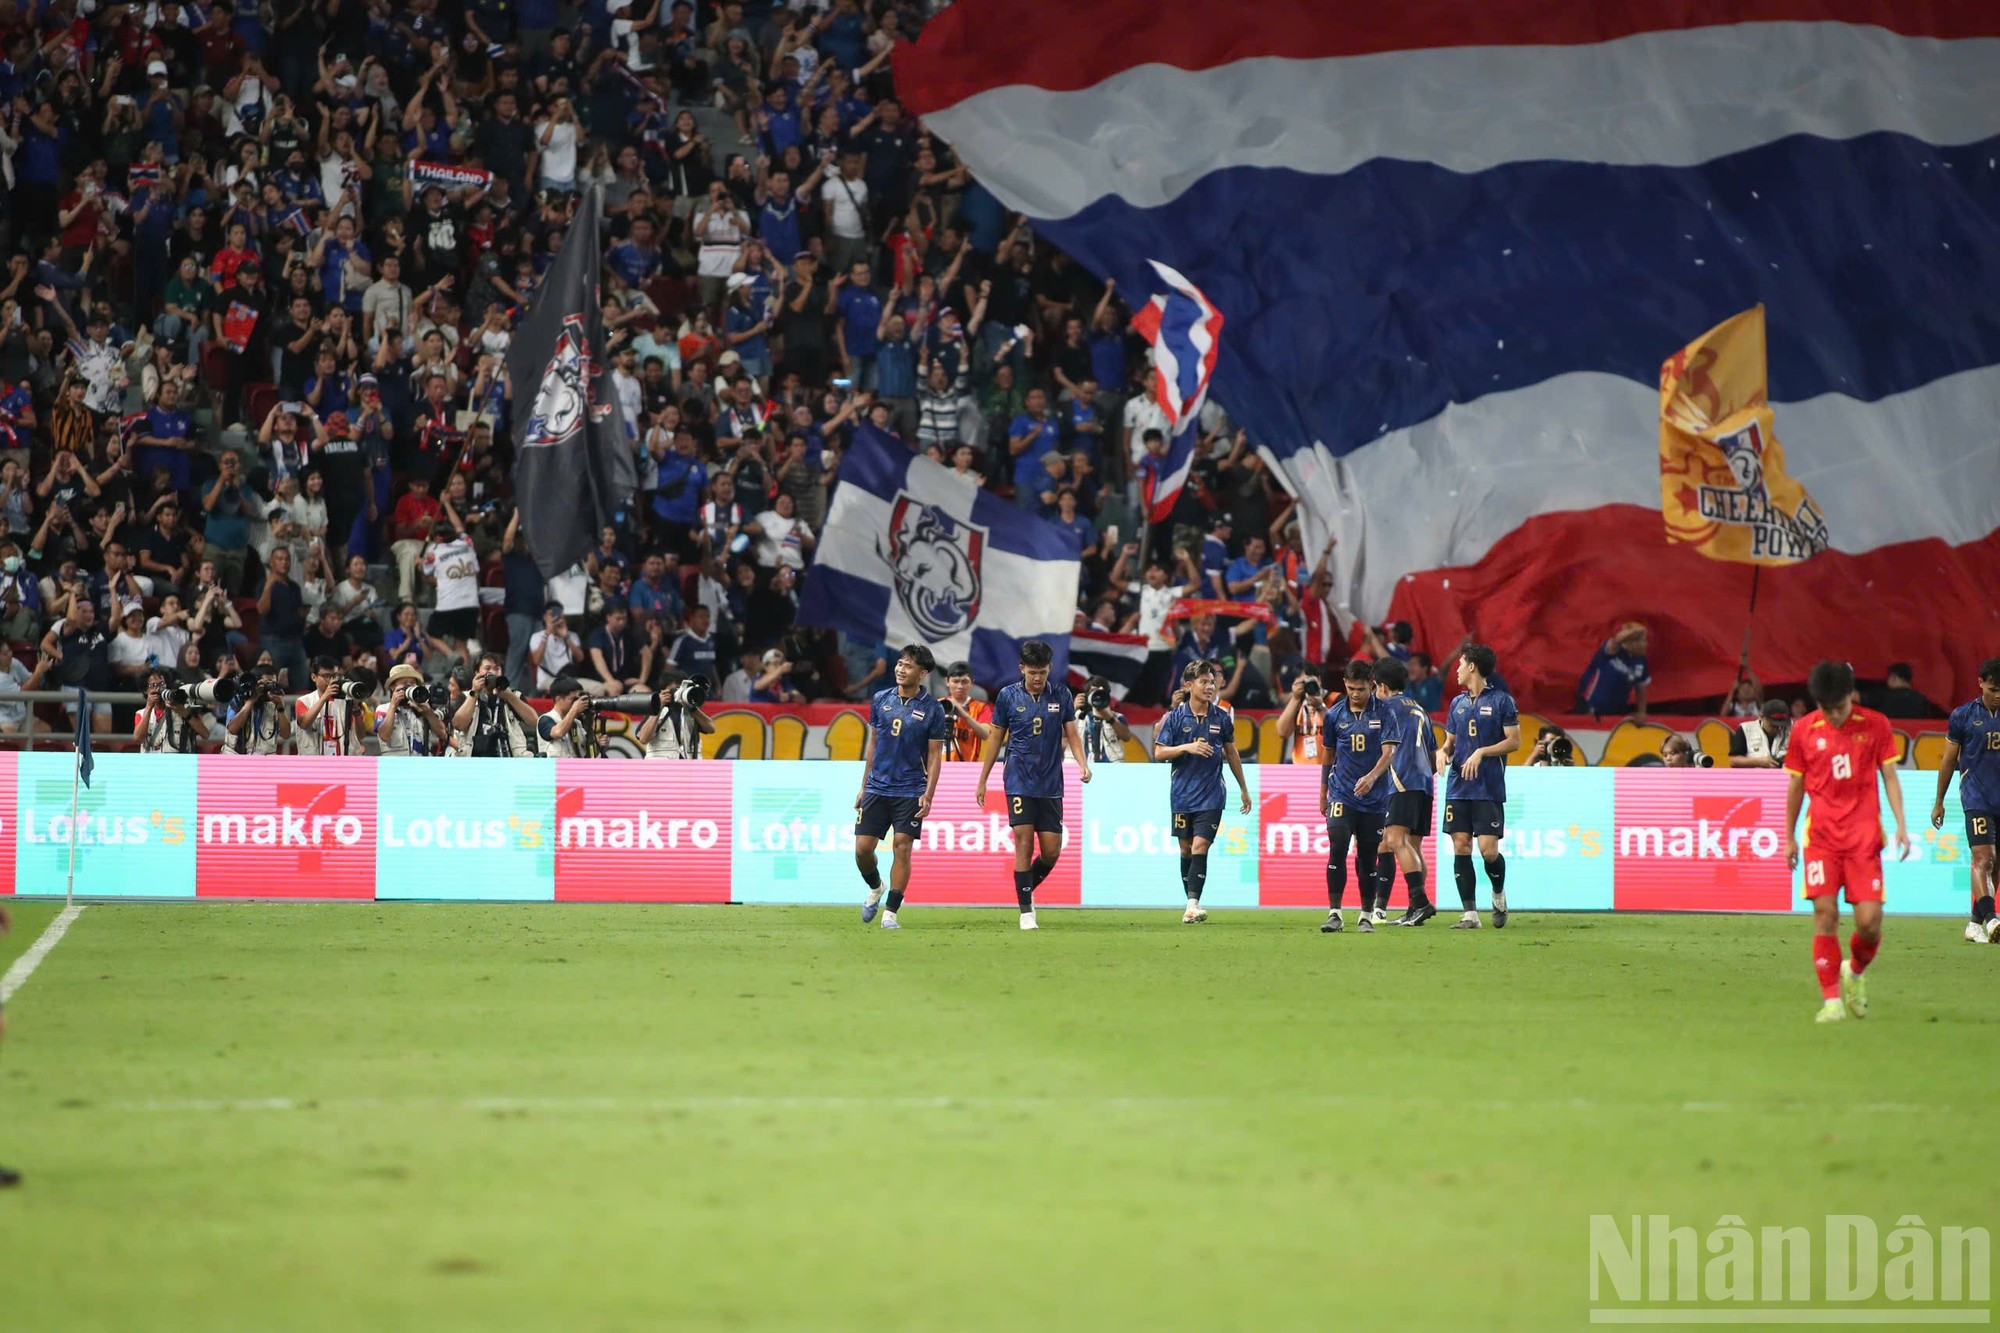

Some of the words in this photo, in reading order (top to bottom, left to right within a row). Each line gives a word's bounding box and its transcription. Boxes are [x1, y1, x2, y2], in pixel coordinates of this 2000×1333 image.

[418, 165, 484, 184] THAILAND
[891, 718, 902, 736] 9
[1032, 717, 1043, 735] 2
[1410, 709, 1425, 747] 7
[1468, 719, 1478, 737] 6
[1350, 733, 1366, 752] 18
[1831, 752, 1852, 780] 21
[1012, 796, 1023, 814] 2
[1329, 801, 1343, 818] 18
[1446, 805, 1454, 823] 6
[24, 807, 185, 846] Lotus's
[203, 806, 362, 847] makro
[383, 812, 542, 849] Lotus's
[560, 810, 718, 850] makro
[1174, 813, 1187, 829] 15
[1971, 816, 1988, 836] 12
[913, 813, 1070, 853] mak
[1620, 818, 1779, 859] makro
[1807, 859, 1825, 886] 21
